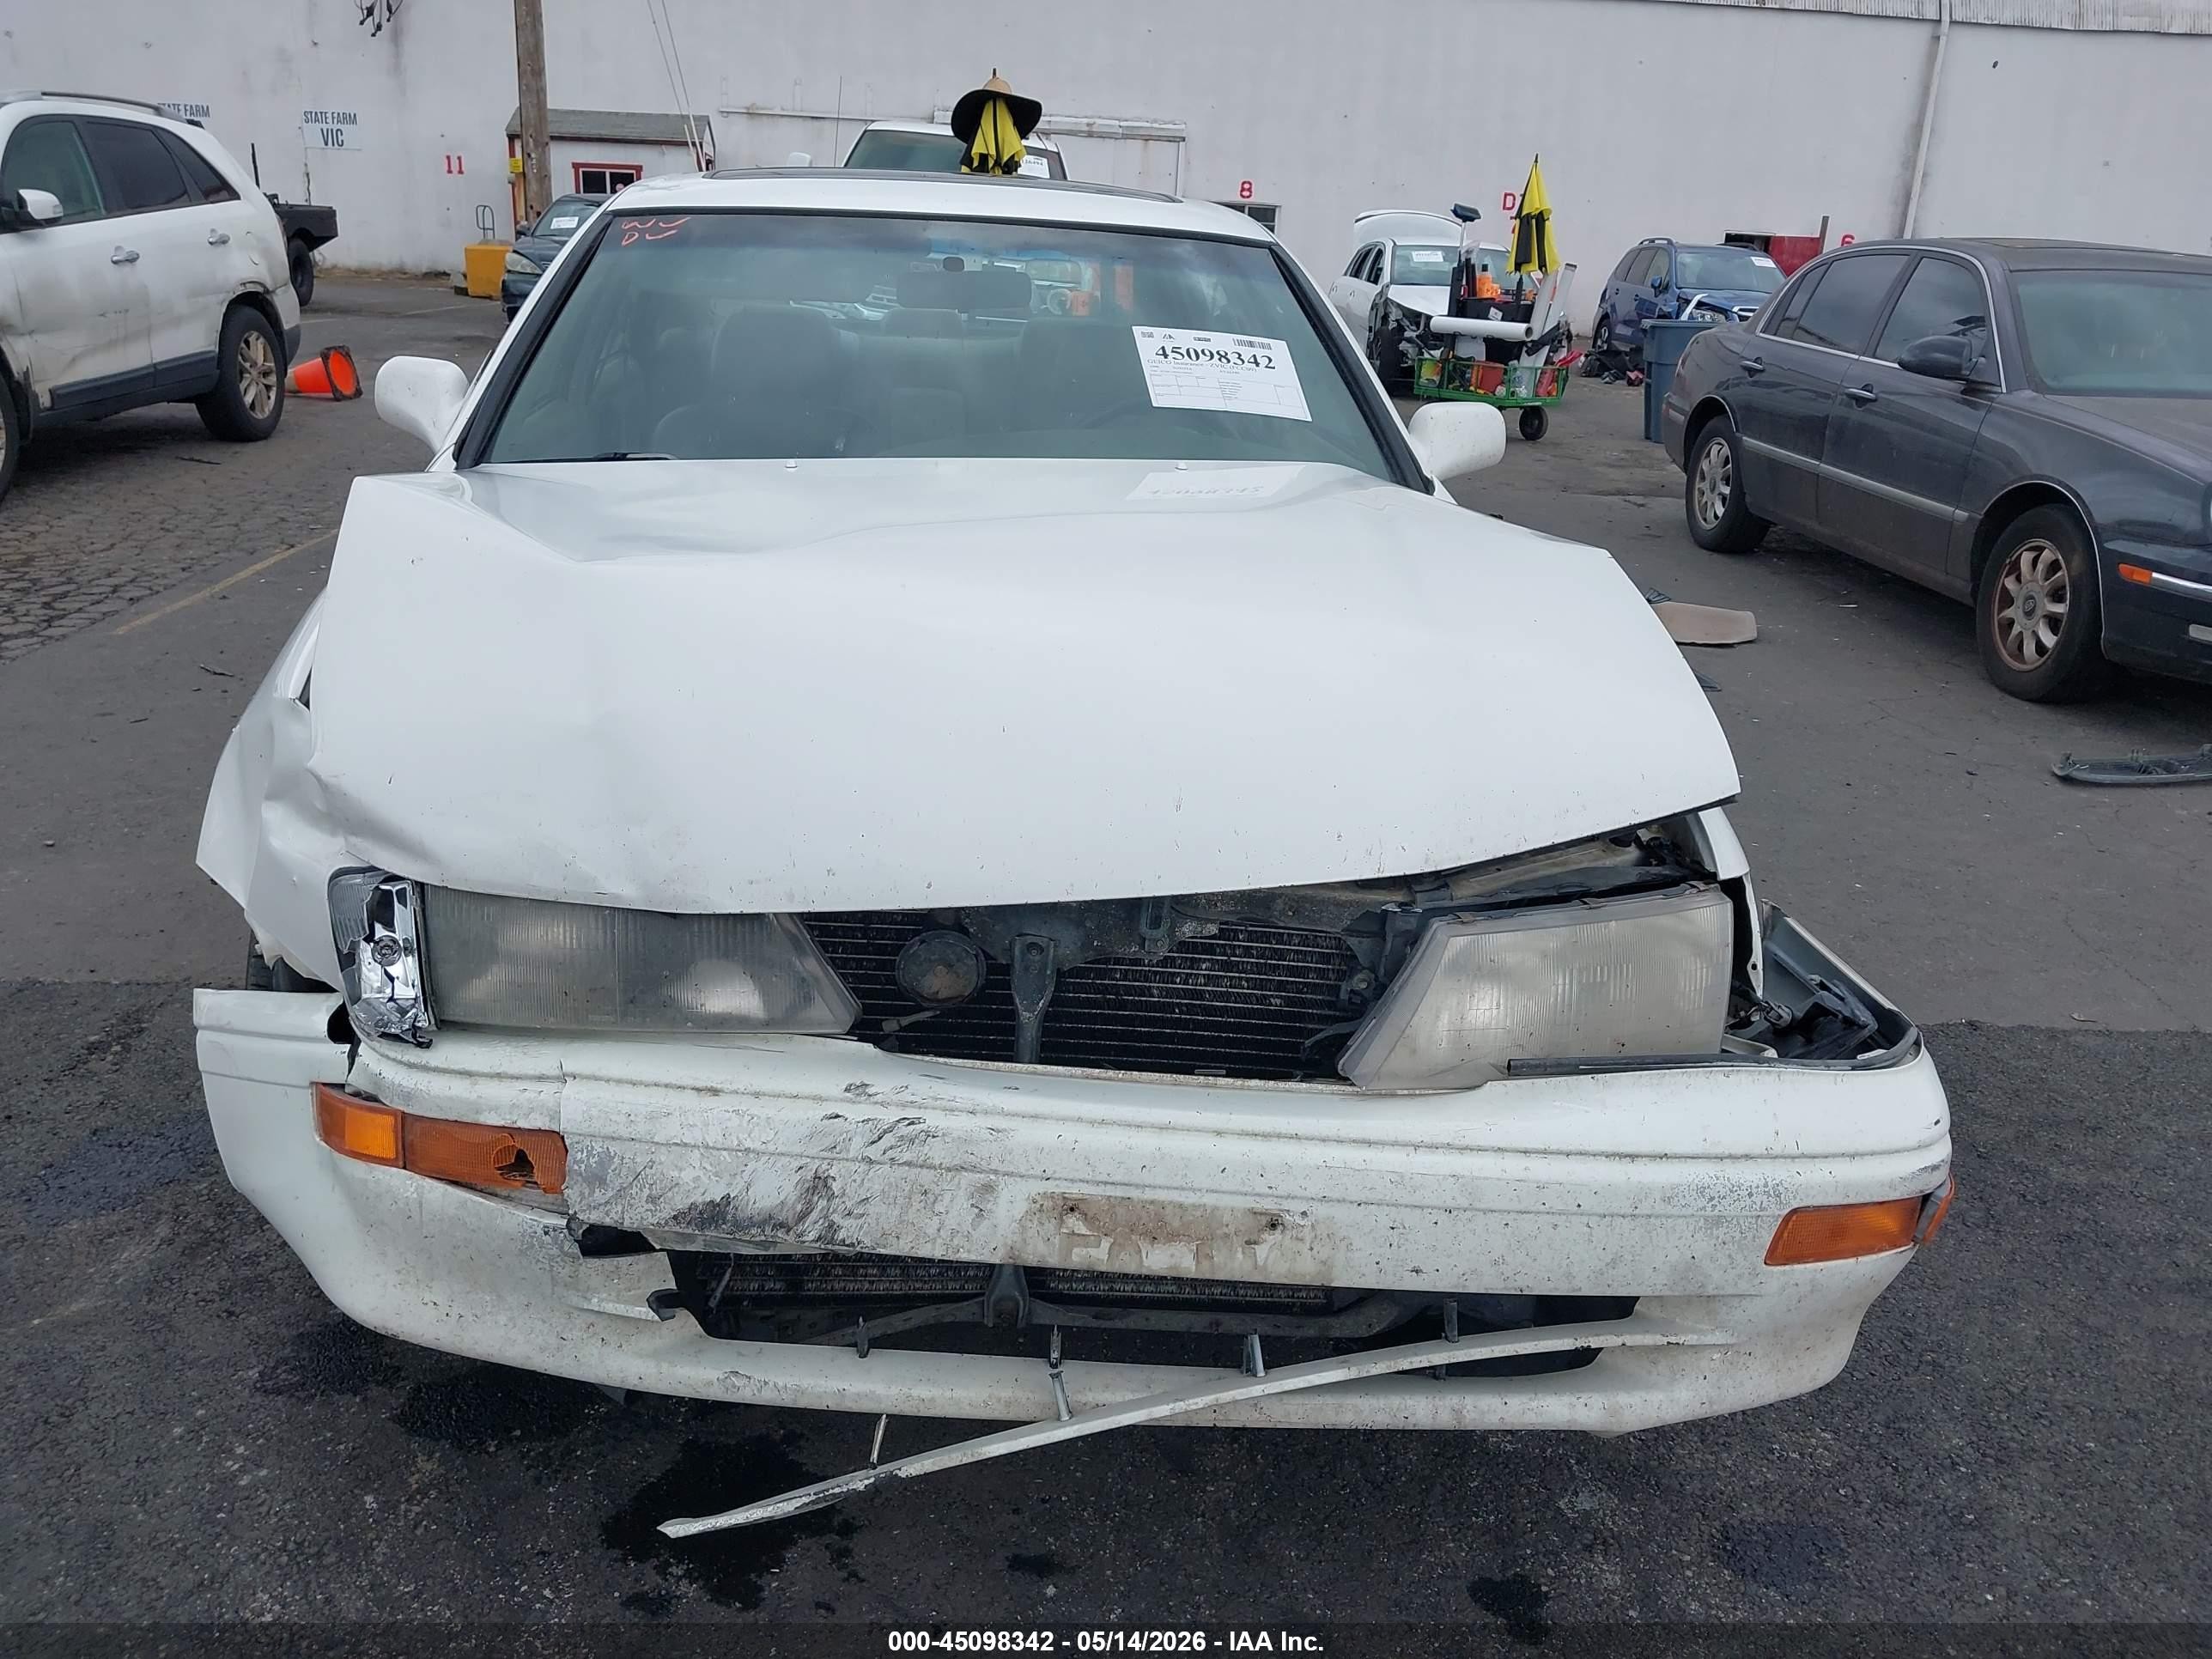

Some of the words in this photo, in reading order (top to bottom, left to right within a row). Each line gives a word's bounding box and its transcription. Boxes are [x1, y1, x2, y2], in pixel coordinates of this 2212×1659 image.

[184, 104, 210, 118] FARM
[303, 111, 330, 125] STATE
[331, 112, 358, 125] FARM
[320, 127, 344, 147] VIC
[446, 155, 465, 174] 11
[1239, 180, 1253, 198] 8
[1154, 344, 1276, 370] 45098342
